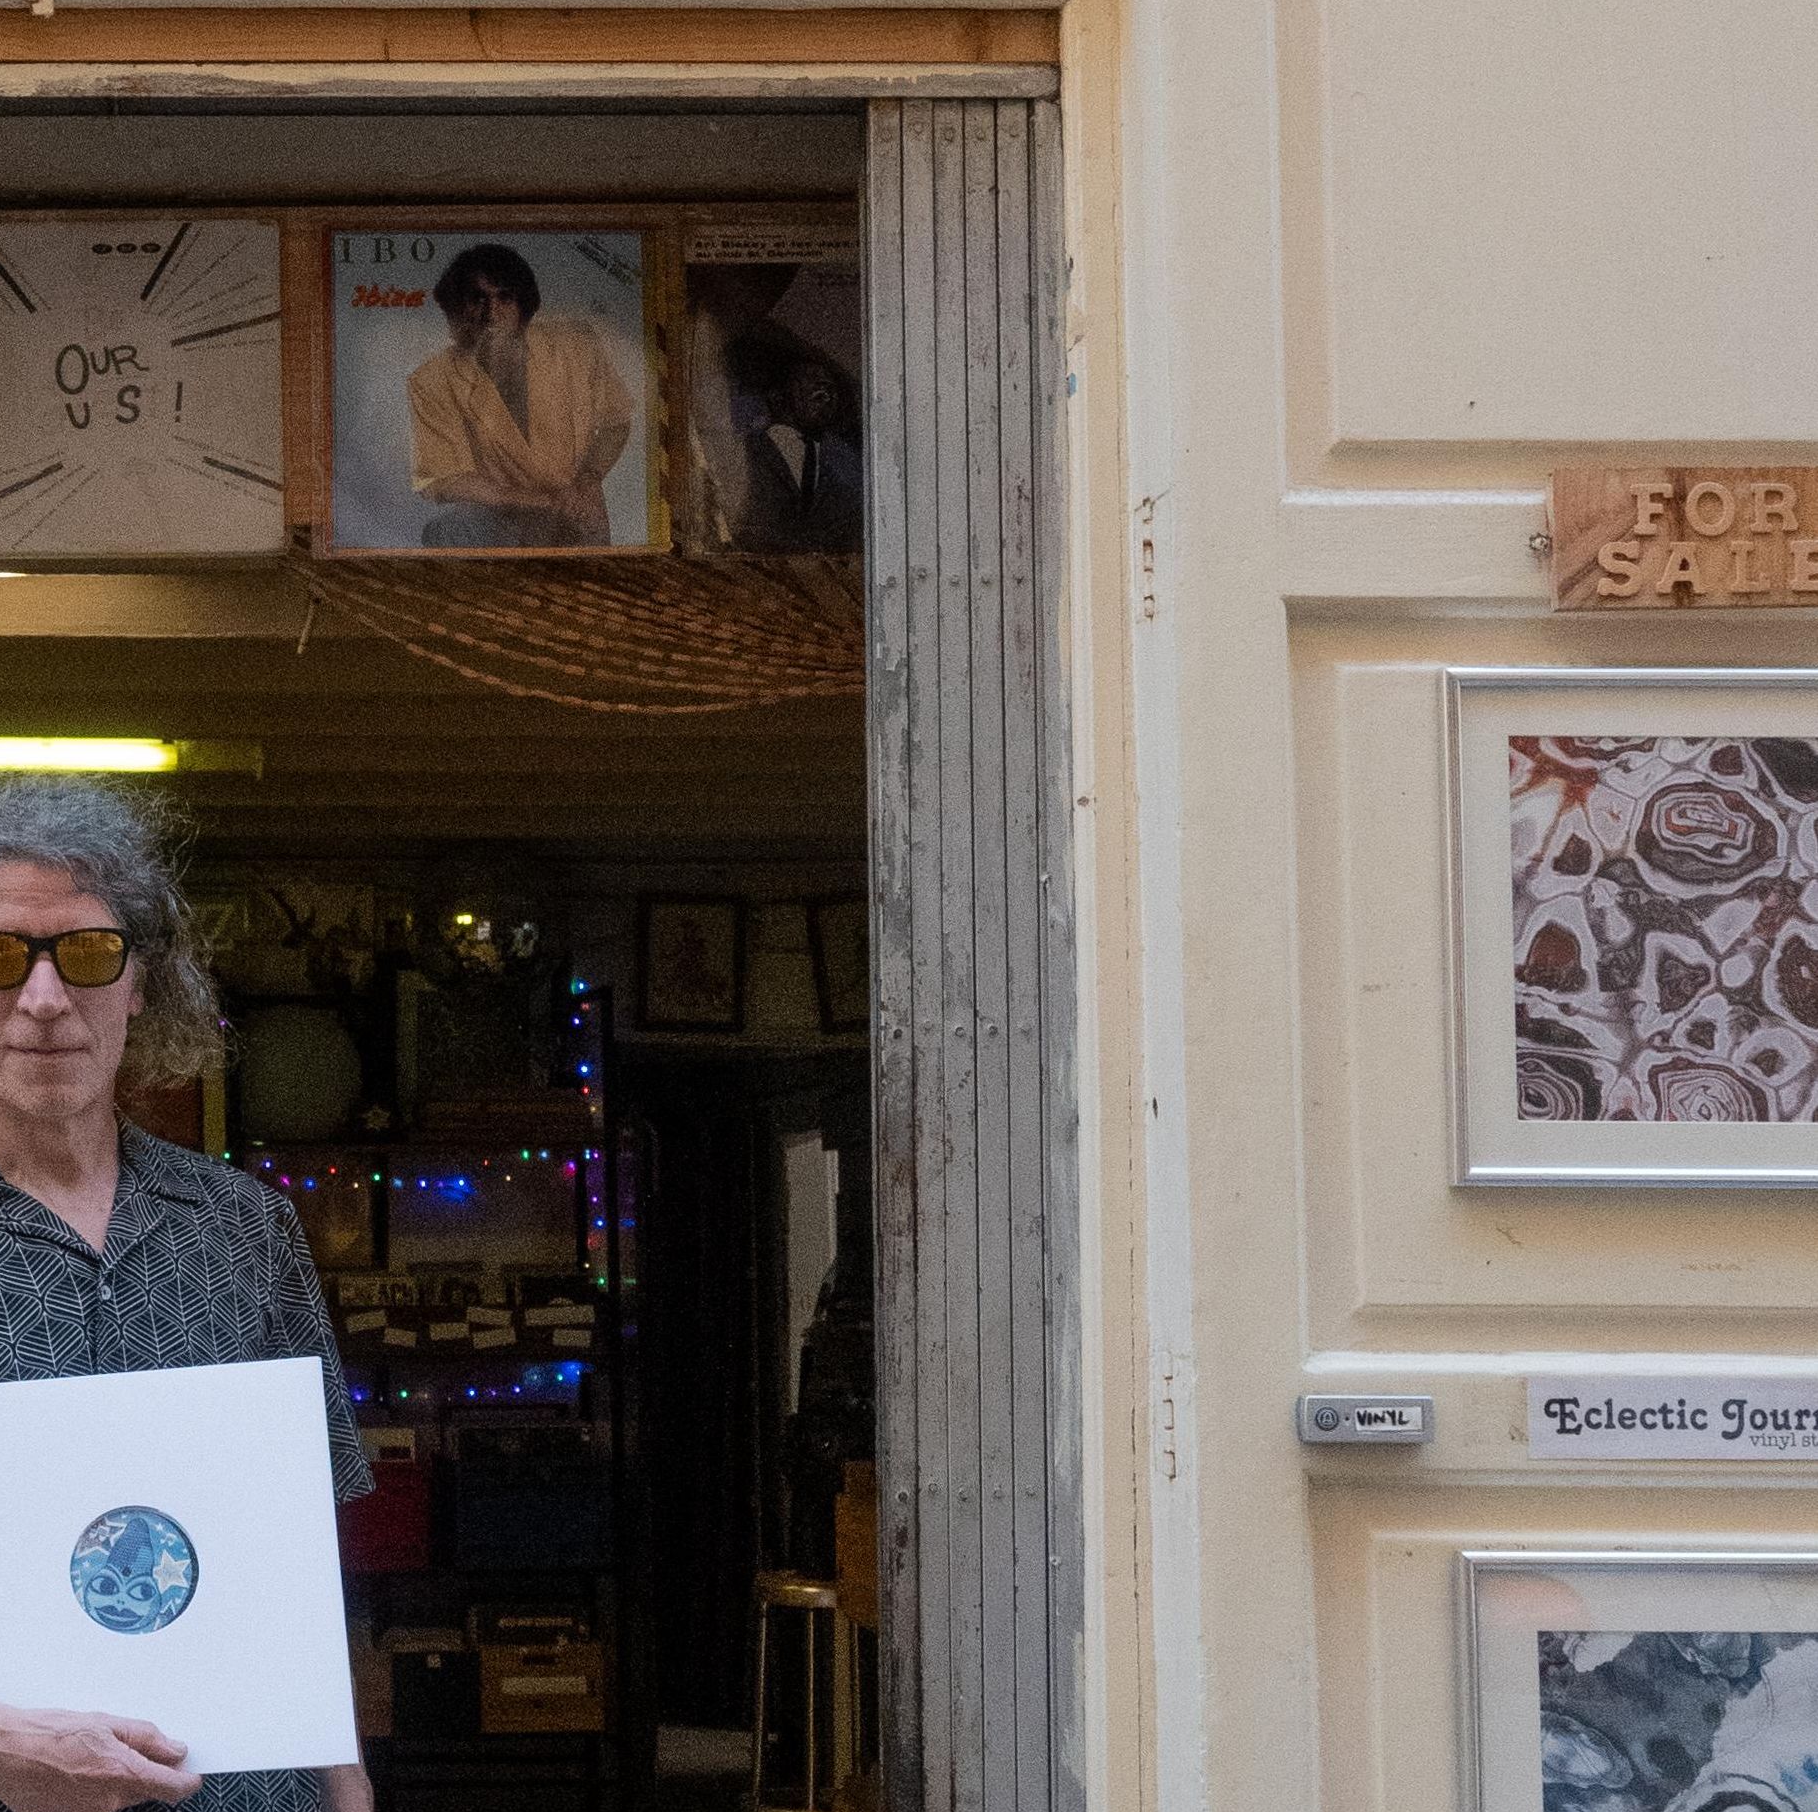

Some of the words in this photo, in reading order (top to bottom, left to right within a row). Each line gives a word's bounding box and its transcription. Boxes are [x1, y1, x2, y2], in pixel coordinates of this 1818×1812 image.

[55, 344, 150, 395] OUR
[1630, 482, 1799, 537] FOR
[1596, 541, 1818, 597] SALE
[1356, 1409, 1410, 1426] VINYL
[1544, 1397, 1708, 1435] Eclectic
[1748, 1432, 1797, 1450] vinyl
